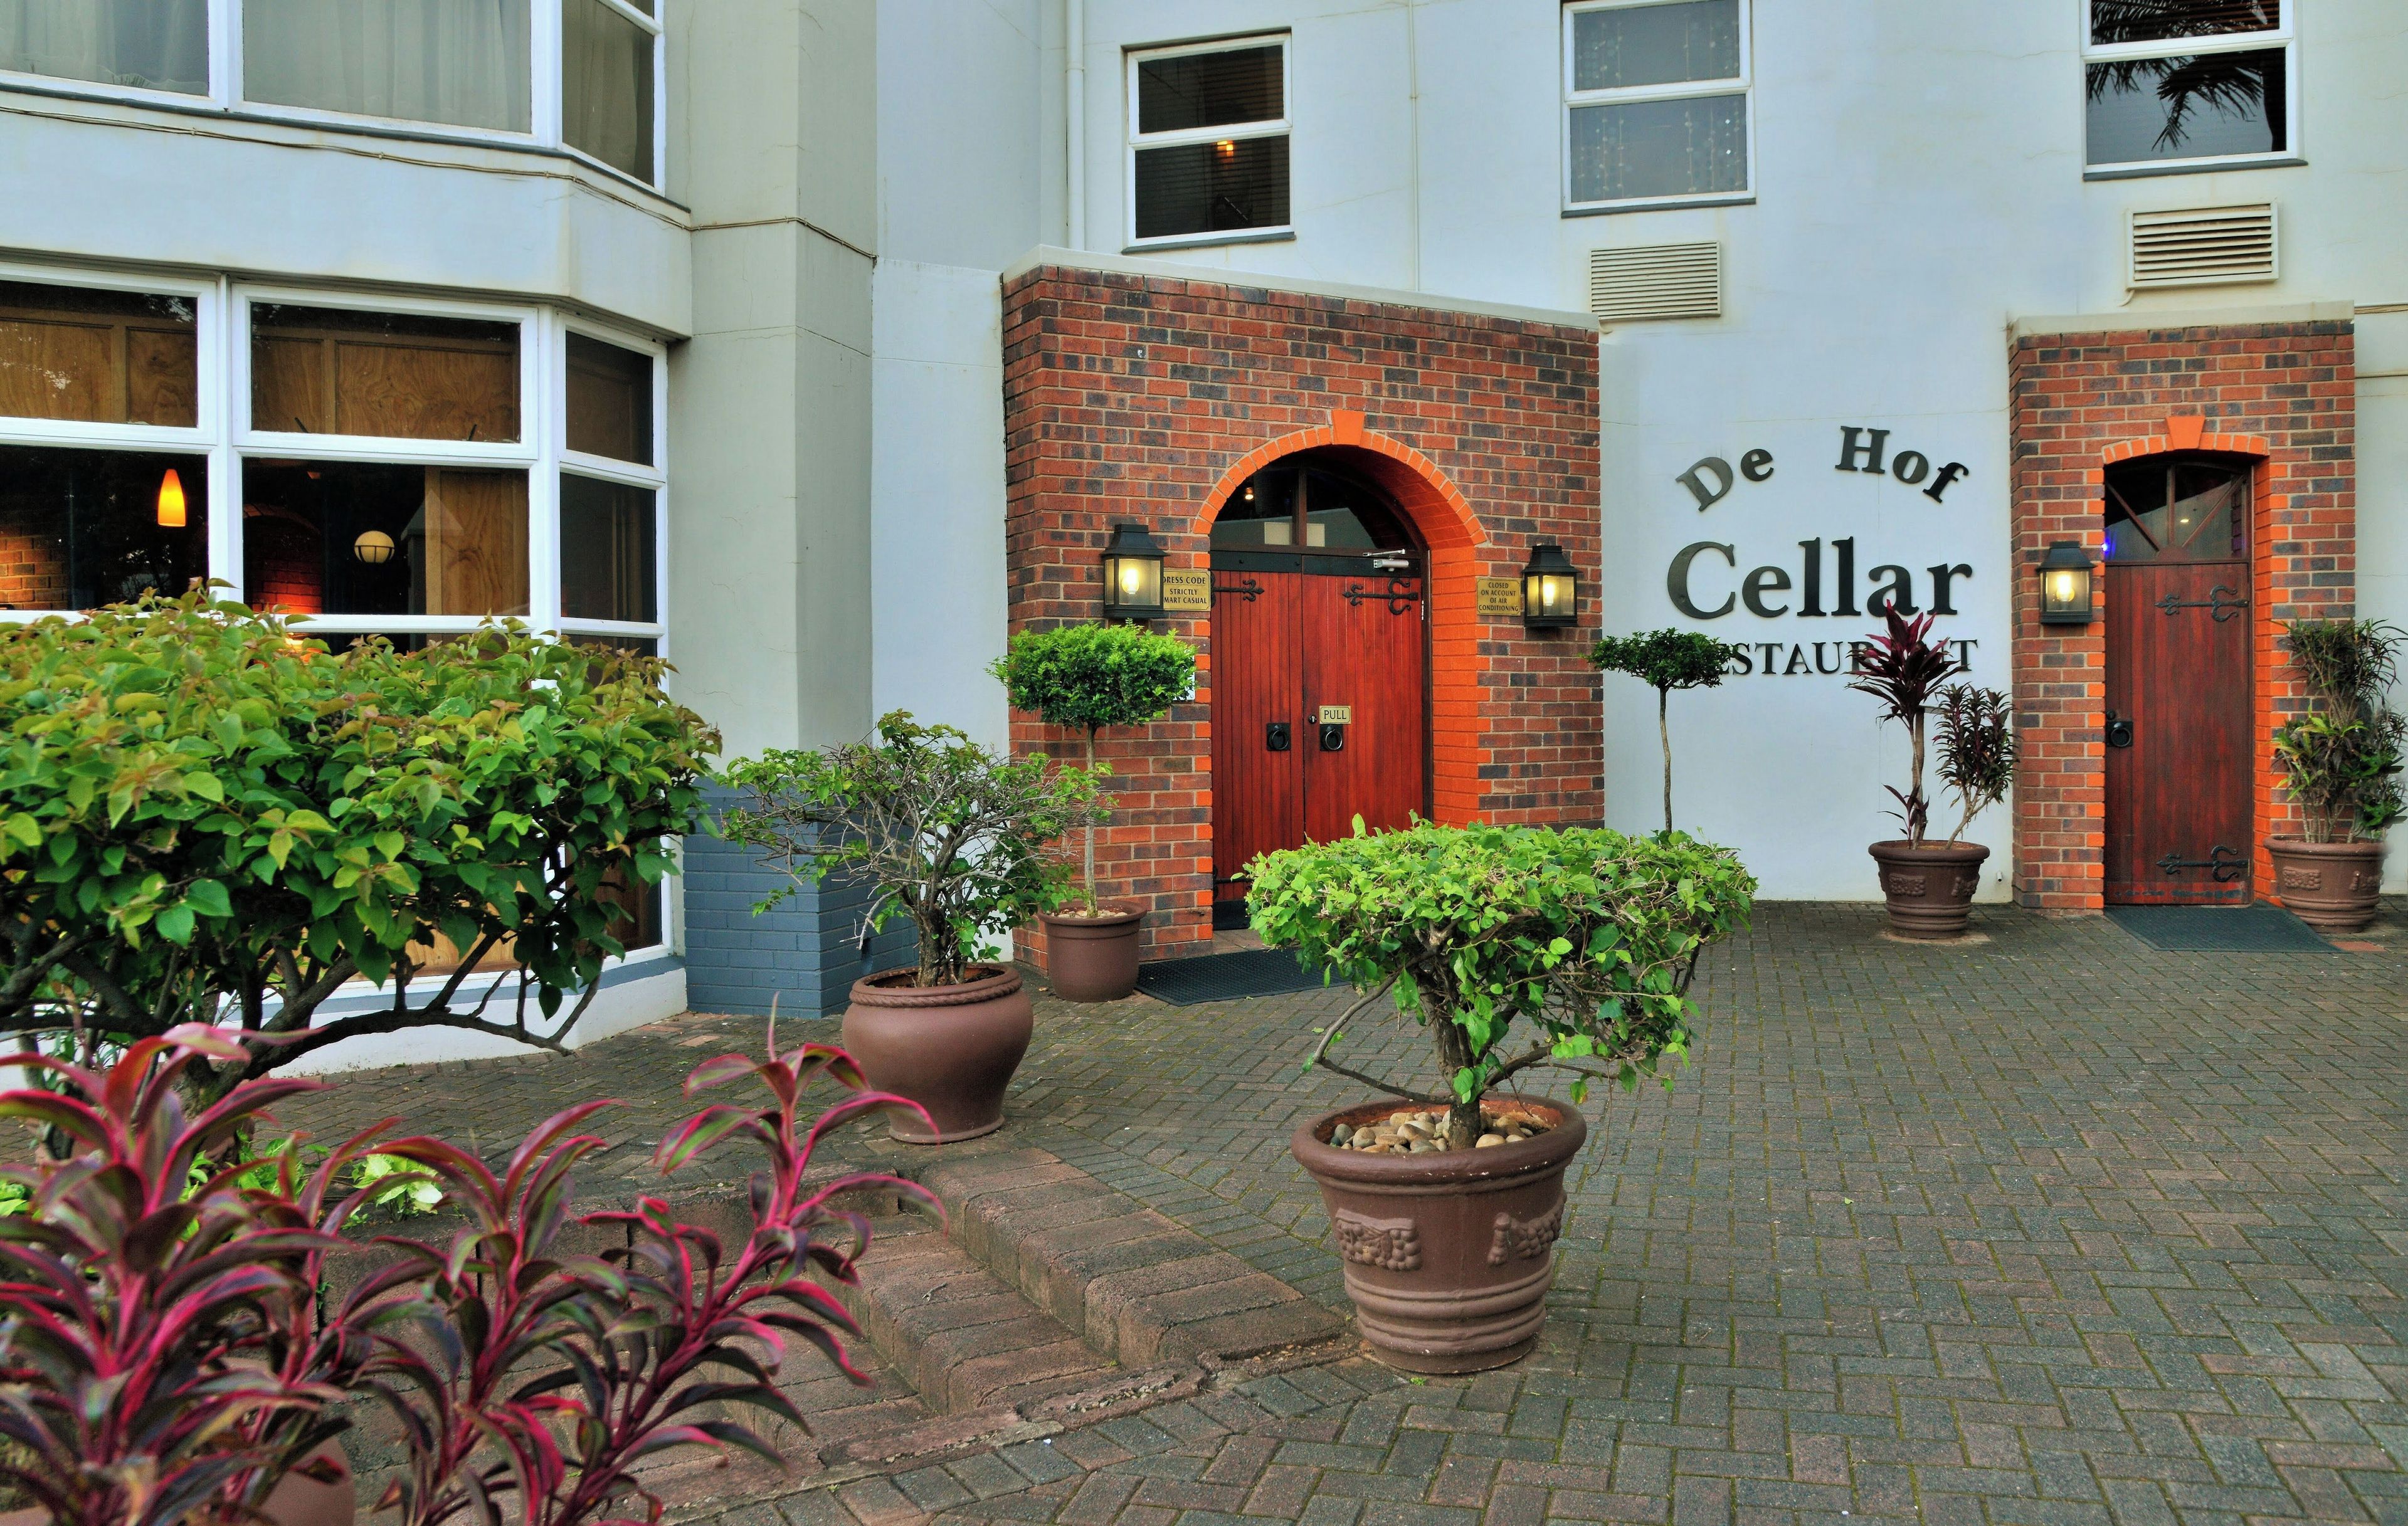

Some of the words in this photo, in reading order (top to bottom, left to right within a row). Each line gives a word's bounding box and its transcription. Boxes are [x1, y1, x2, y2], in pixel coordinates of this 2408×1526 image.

[1675, 448, 1774, 512] De
[1835, 425, 1969, 503] Hof
[1667, 536, 1973, 619] Cellar
[1324, 710, 1347, 720] PULL
